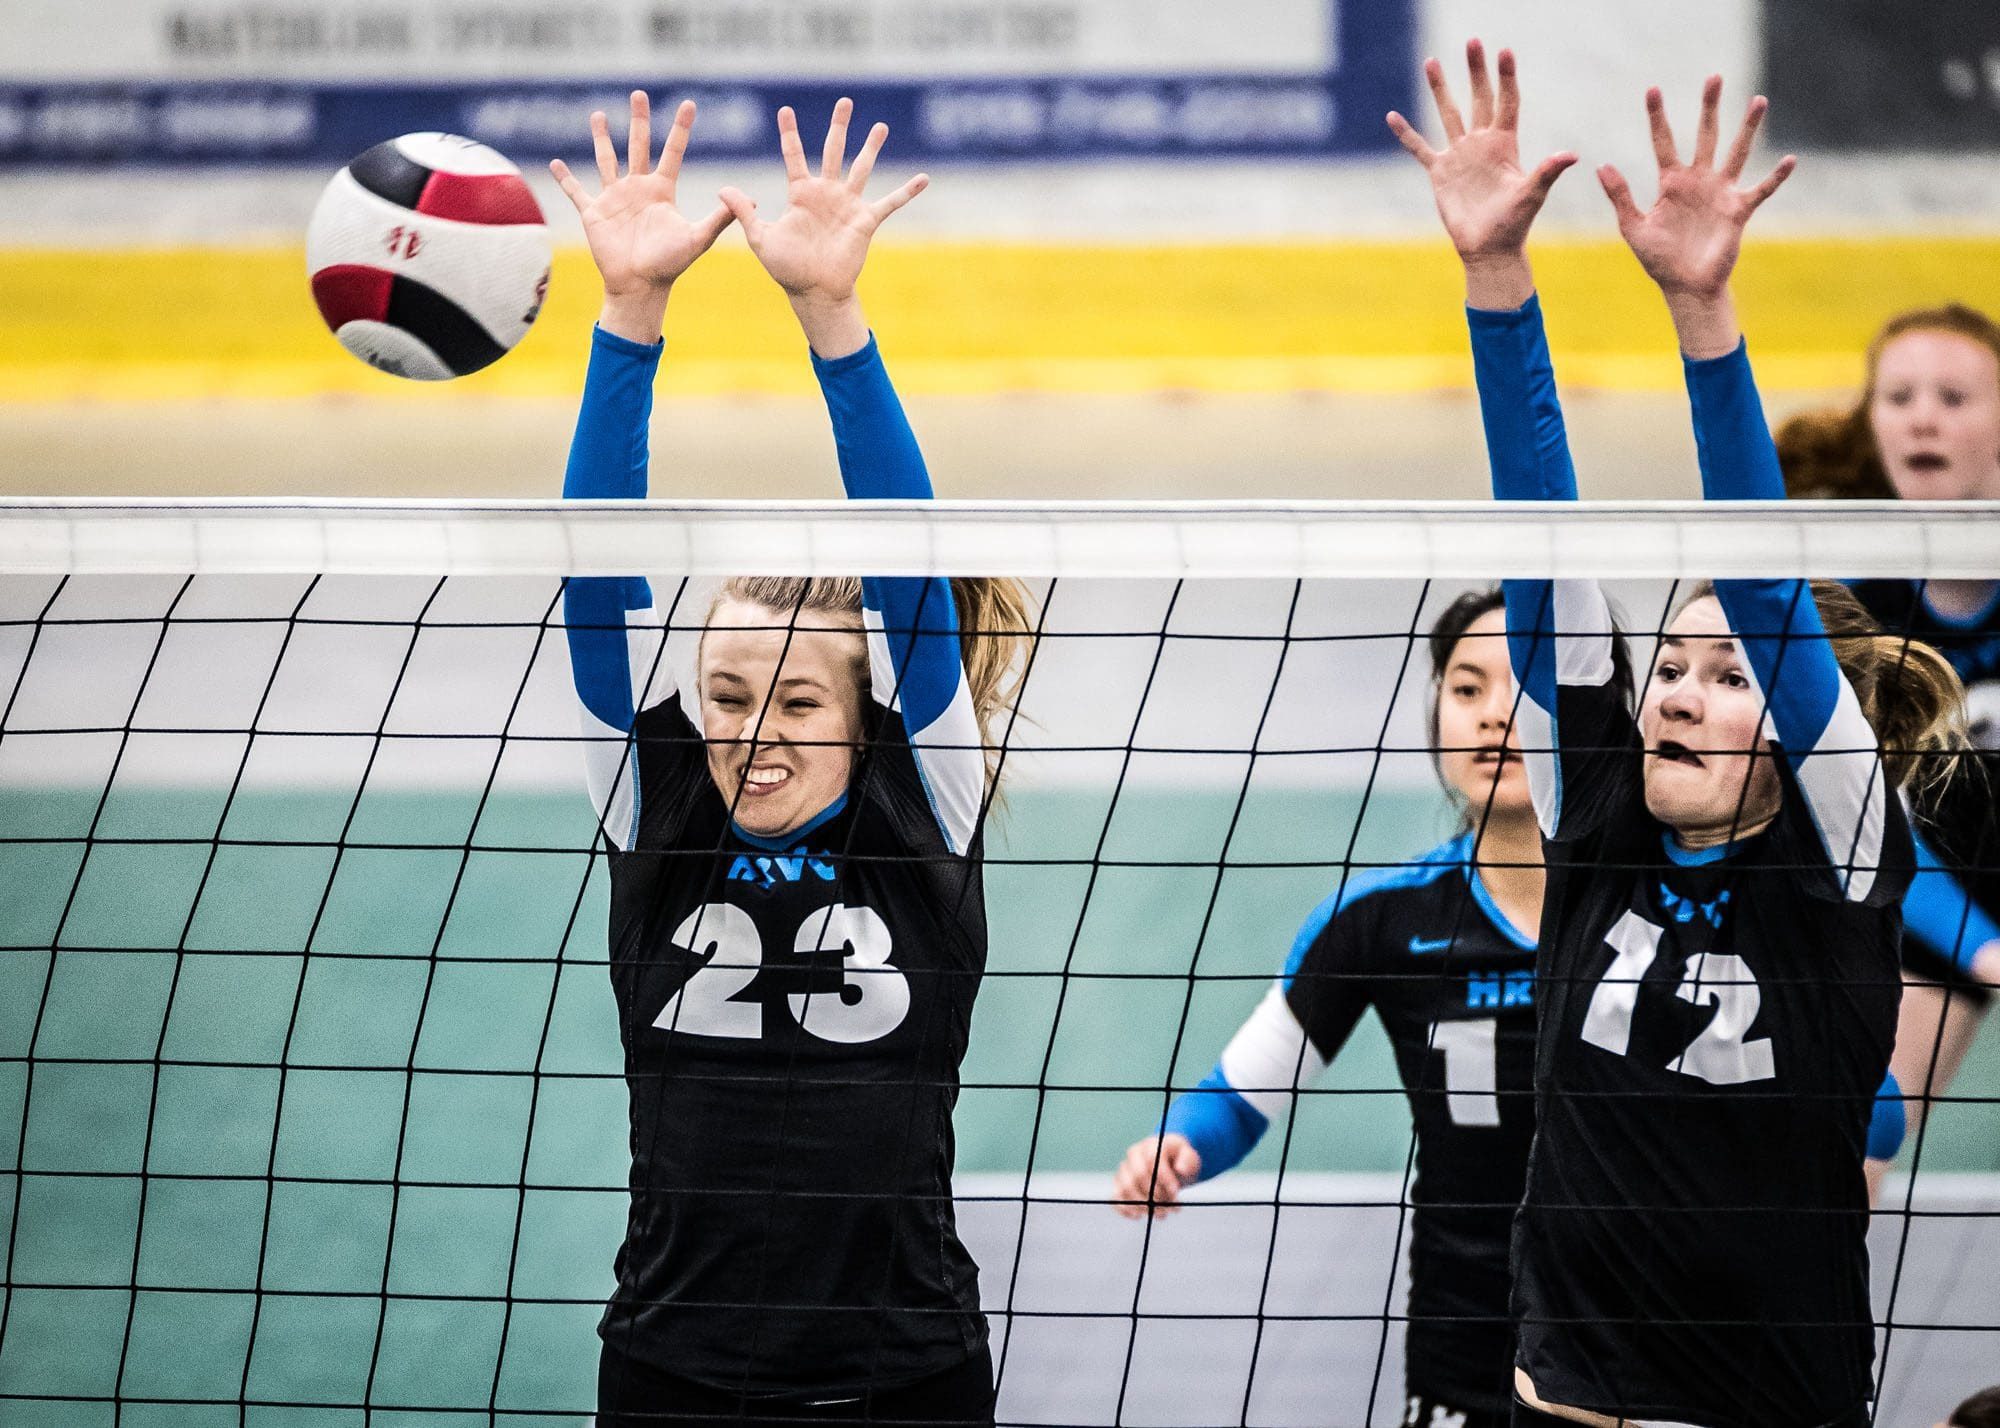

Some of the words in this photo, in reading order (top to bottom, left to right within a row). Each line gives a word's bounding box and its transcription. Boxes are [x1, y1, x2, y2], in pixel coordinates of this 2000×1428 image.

[651, 902, 911, 1044] 23
[1580, 909, 1776, 1086] 12
[1428, 1017, 1501, 1127] 1
